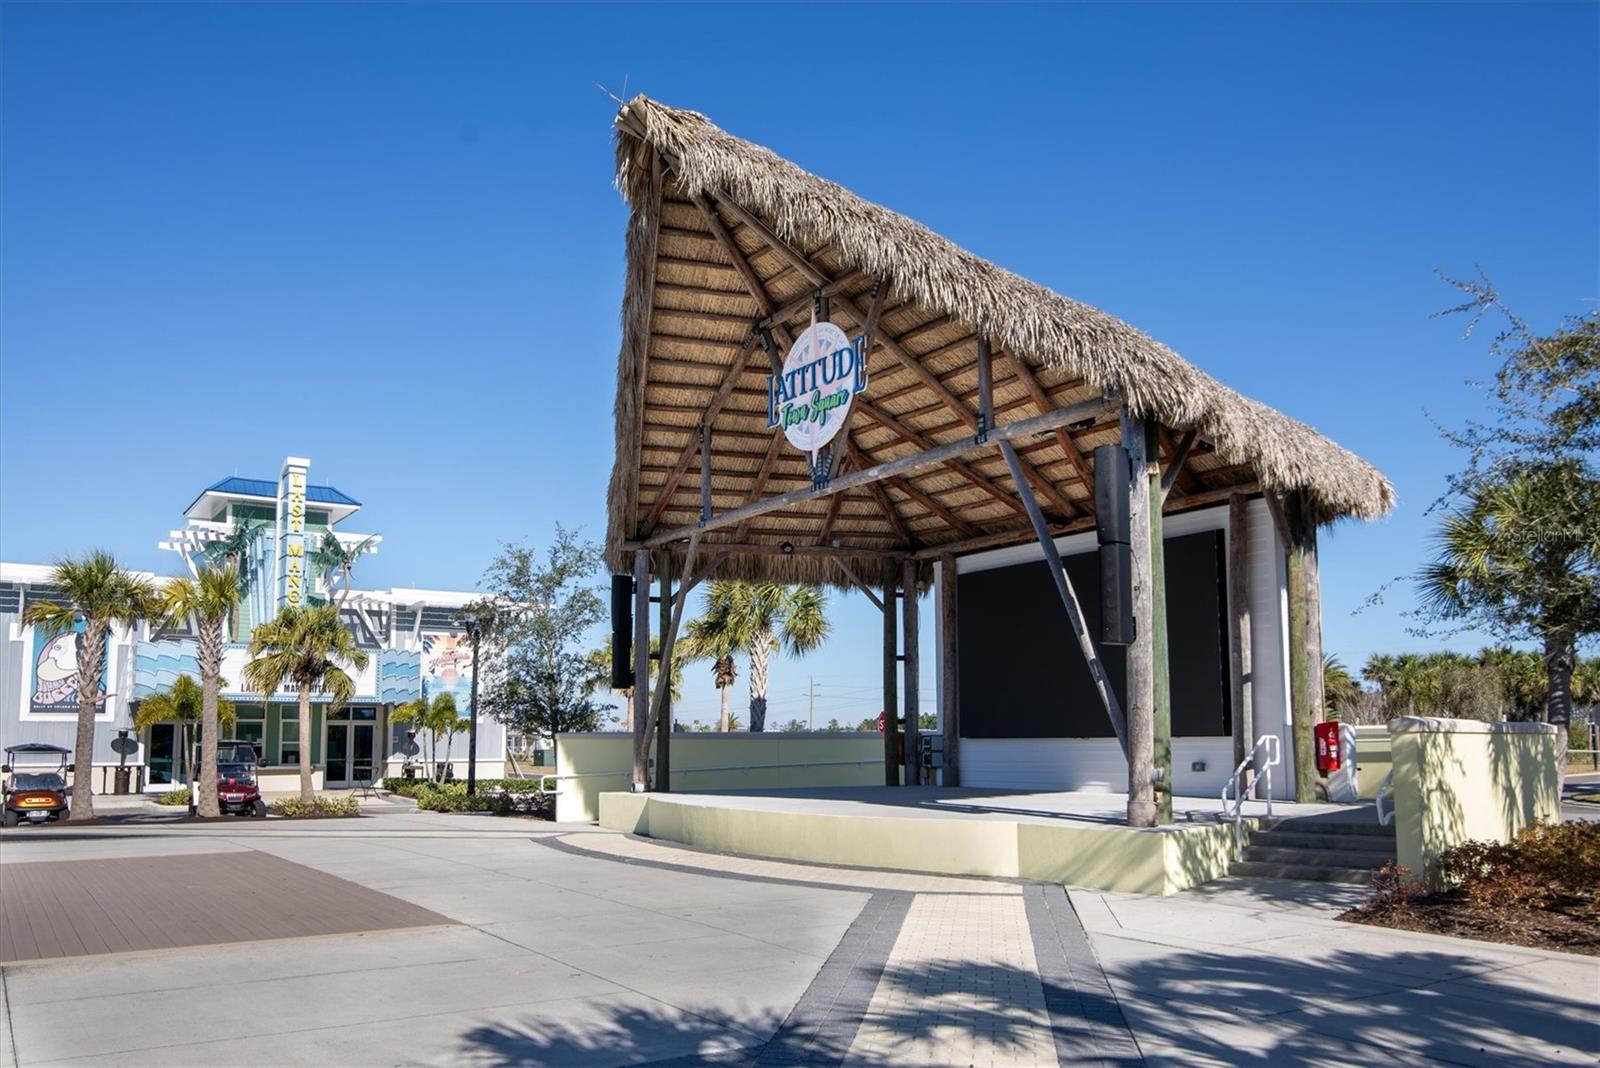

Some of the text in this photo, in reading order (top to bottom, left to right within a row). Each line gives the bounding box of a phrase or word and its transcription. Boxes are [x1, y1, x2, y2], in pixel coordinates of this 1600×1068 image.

[767, 334, 868, 428] LATITUDE
[781, 389, 850, 431] Town Square
[286, 474, 303, 606] LAST MANG
